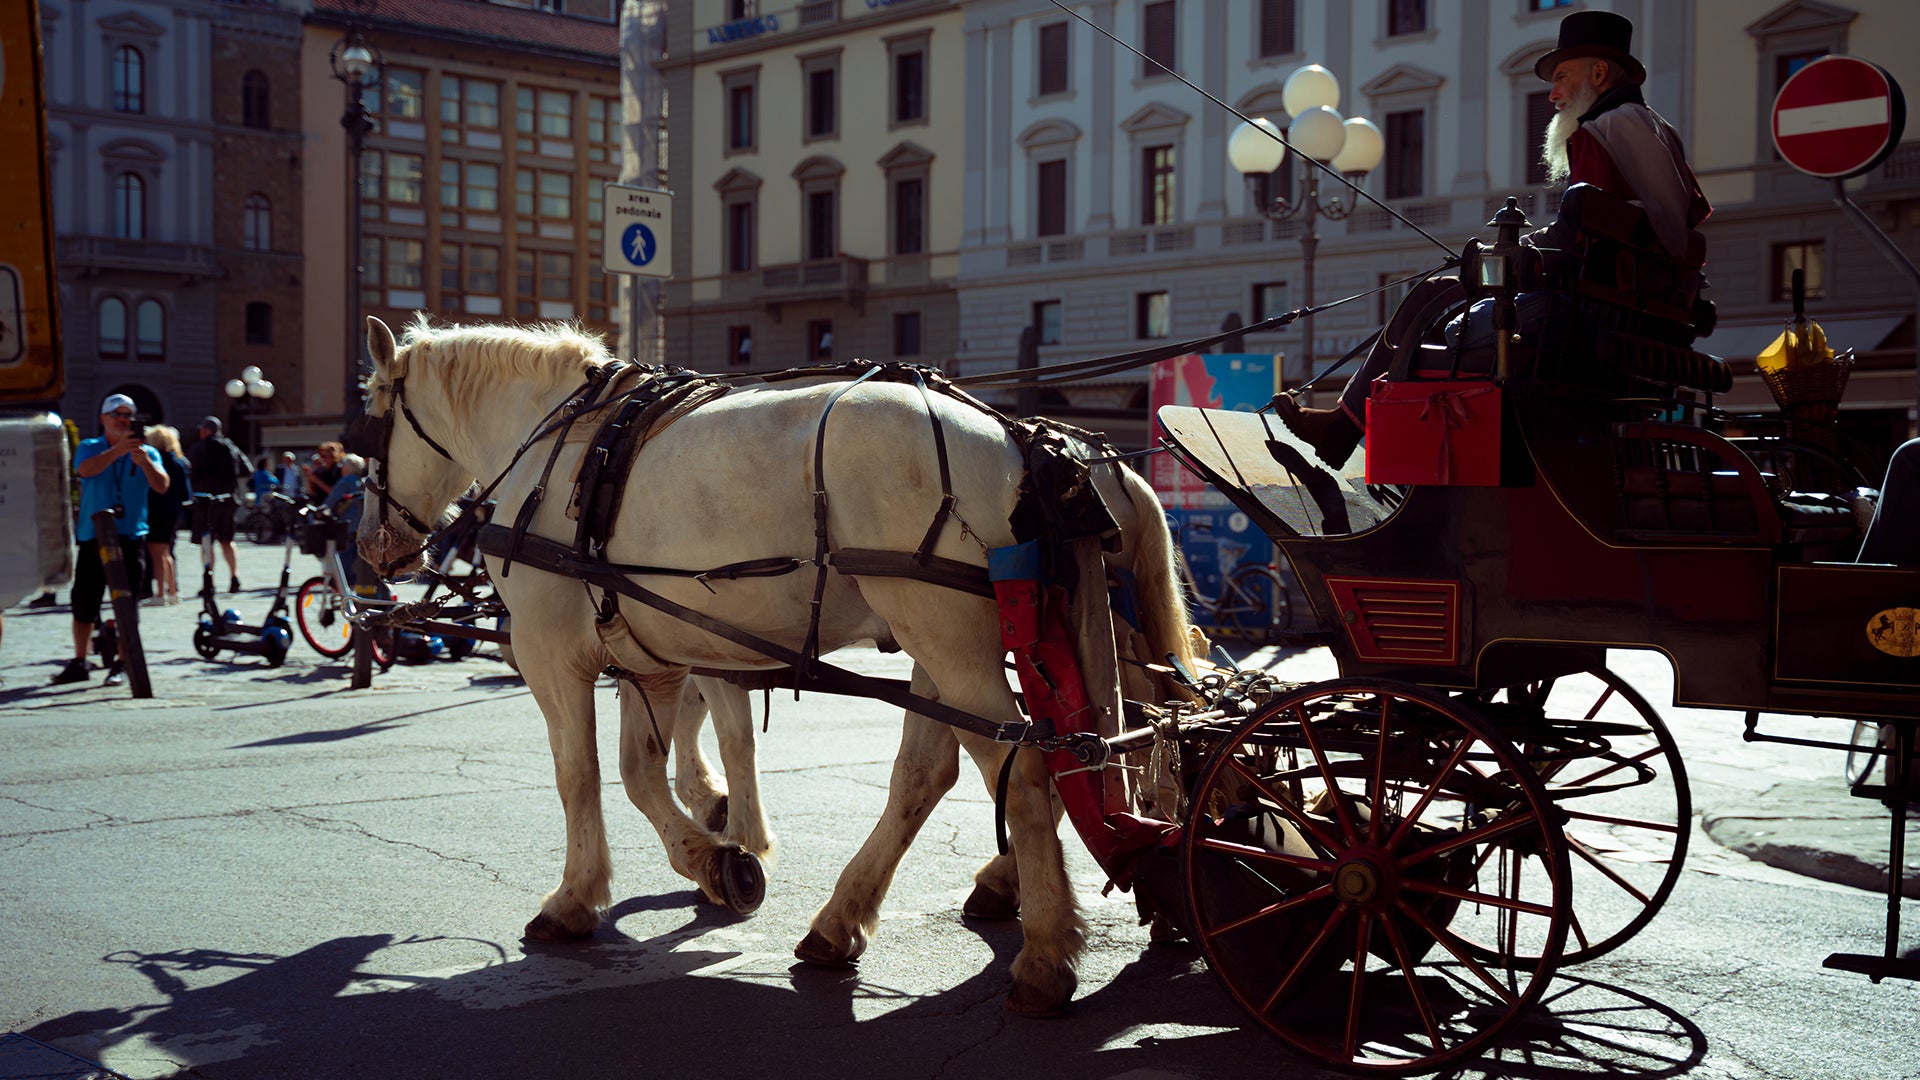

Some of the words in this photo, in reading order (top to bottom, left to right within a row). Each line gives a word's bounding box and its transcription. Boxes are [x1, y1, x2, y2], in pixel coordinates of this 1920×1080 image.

[707, 15, 779, 43] ALBERGO
[629, 194, 650, 204] area
[616, 206, 661, 219] pedonale
